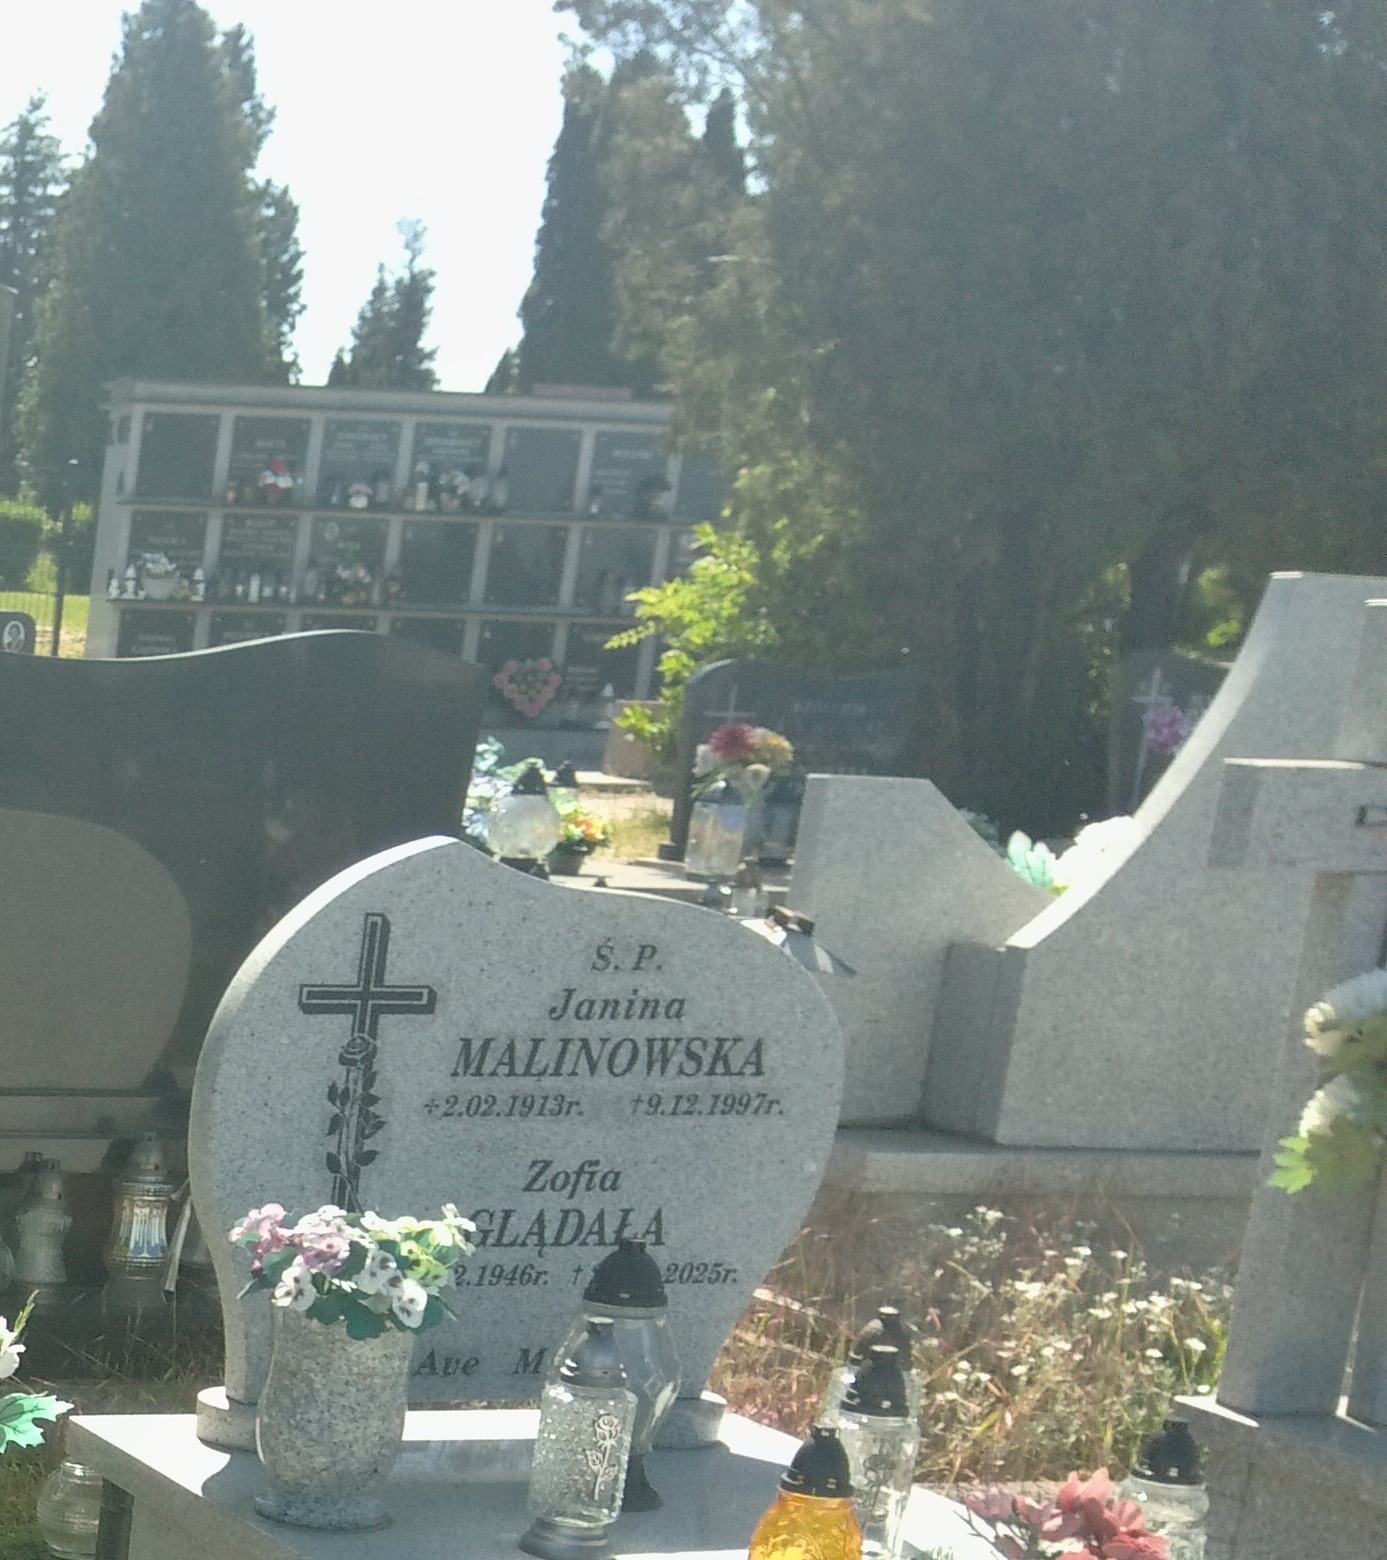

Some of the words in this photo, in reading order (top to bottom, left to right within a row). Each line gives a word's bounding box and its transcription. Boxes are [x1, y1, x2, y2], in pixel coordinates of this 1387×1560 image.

[548, 988, 687, 1021] Janina
[450, 1037, 766, 1077] MALINOWSKA
[522, 1159, 622, 1198] Zofia
